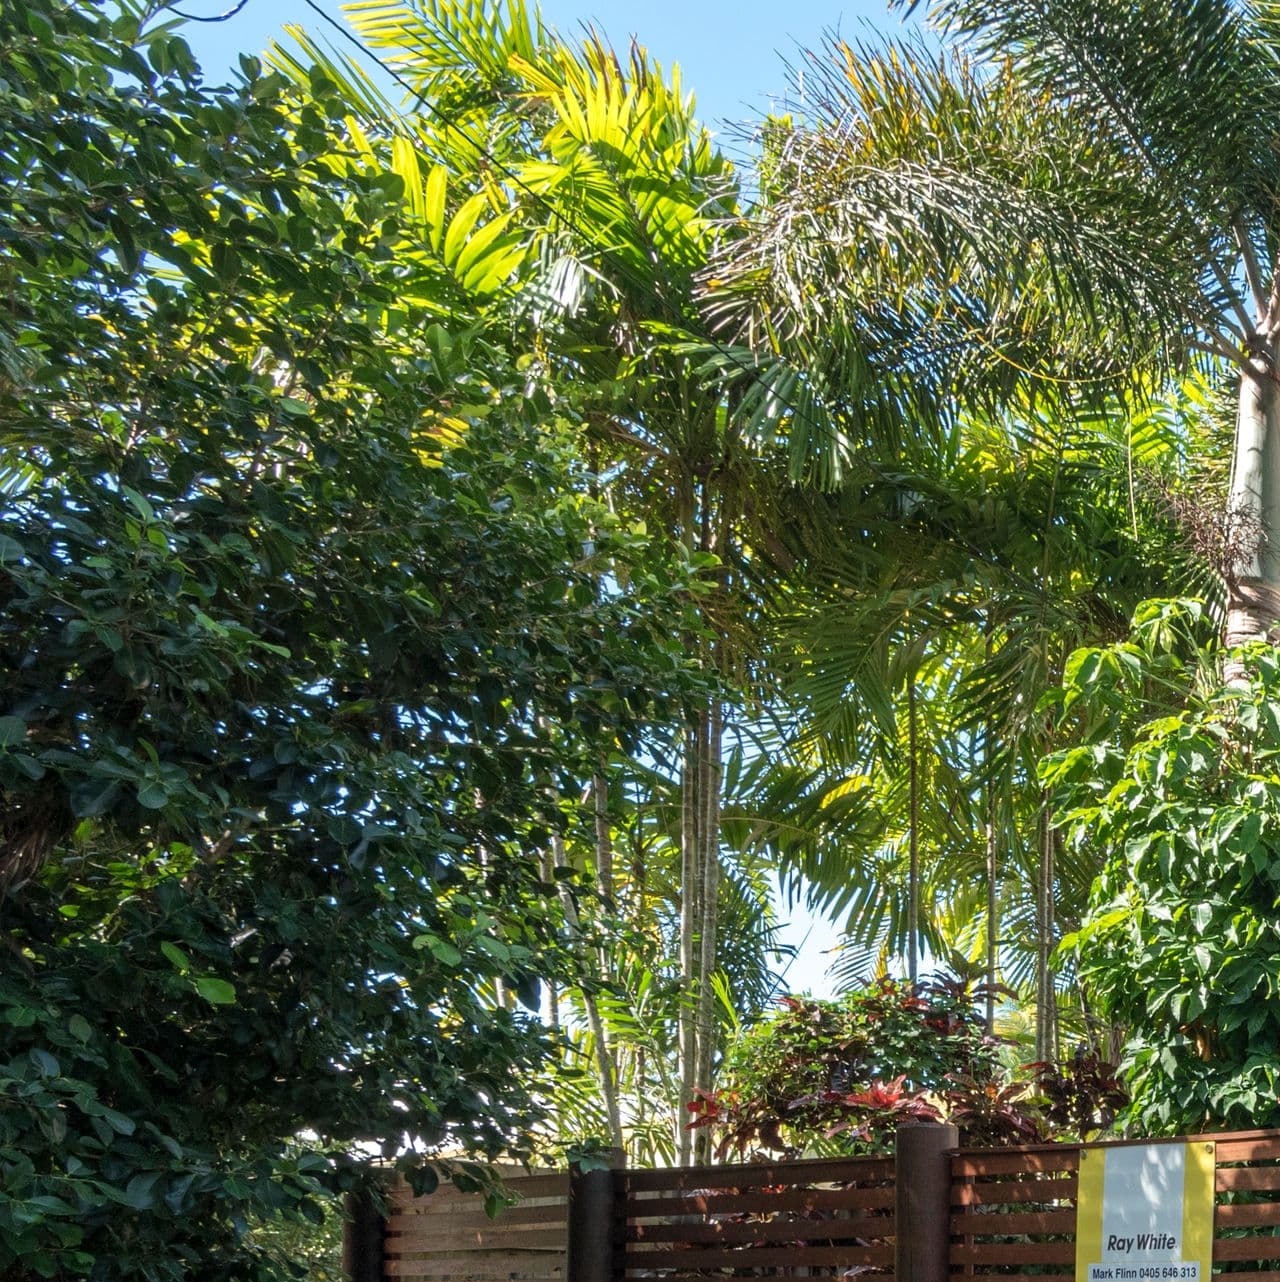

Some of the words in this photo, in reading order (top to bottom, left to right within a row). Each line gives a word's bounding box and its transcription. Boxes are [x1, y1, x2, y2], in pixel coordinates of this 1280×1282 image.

[1107, 1235, 1134, 1253] Ray
[1137, 1233, 1176, 1249] White
[1092, 1268, 1113, 1280] Mark
[1115, 1268, 1137, 1279] Flinn
[1139, 1267, 1160, 1279] 0405
[1162, 1267, 1178, 1279] 646
[1180, 1267, 1197, 1278] 313
